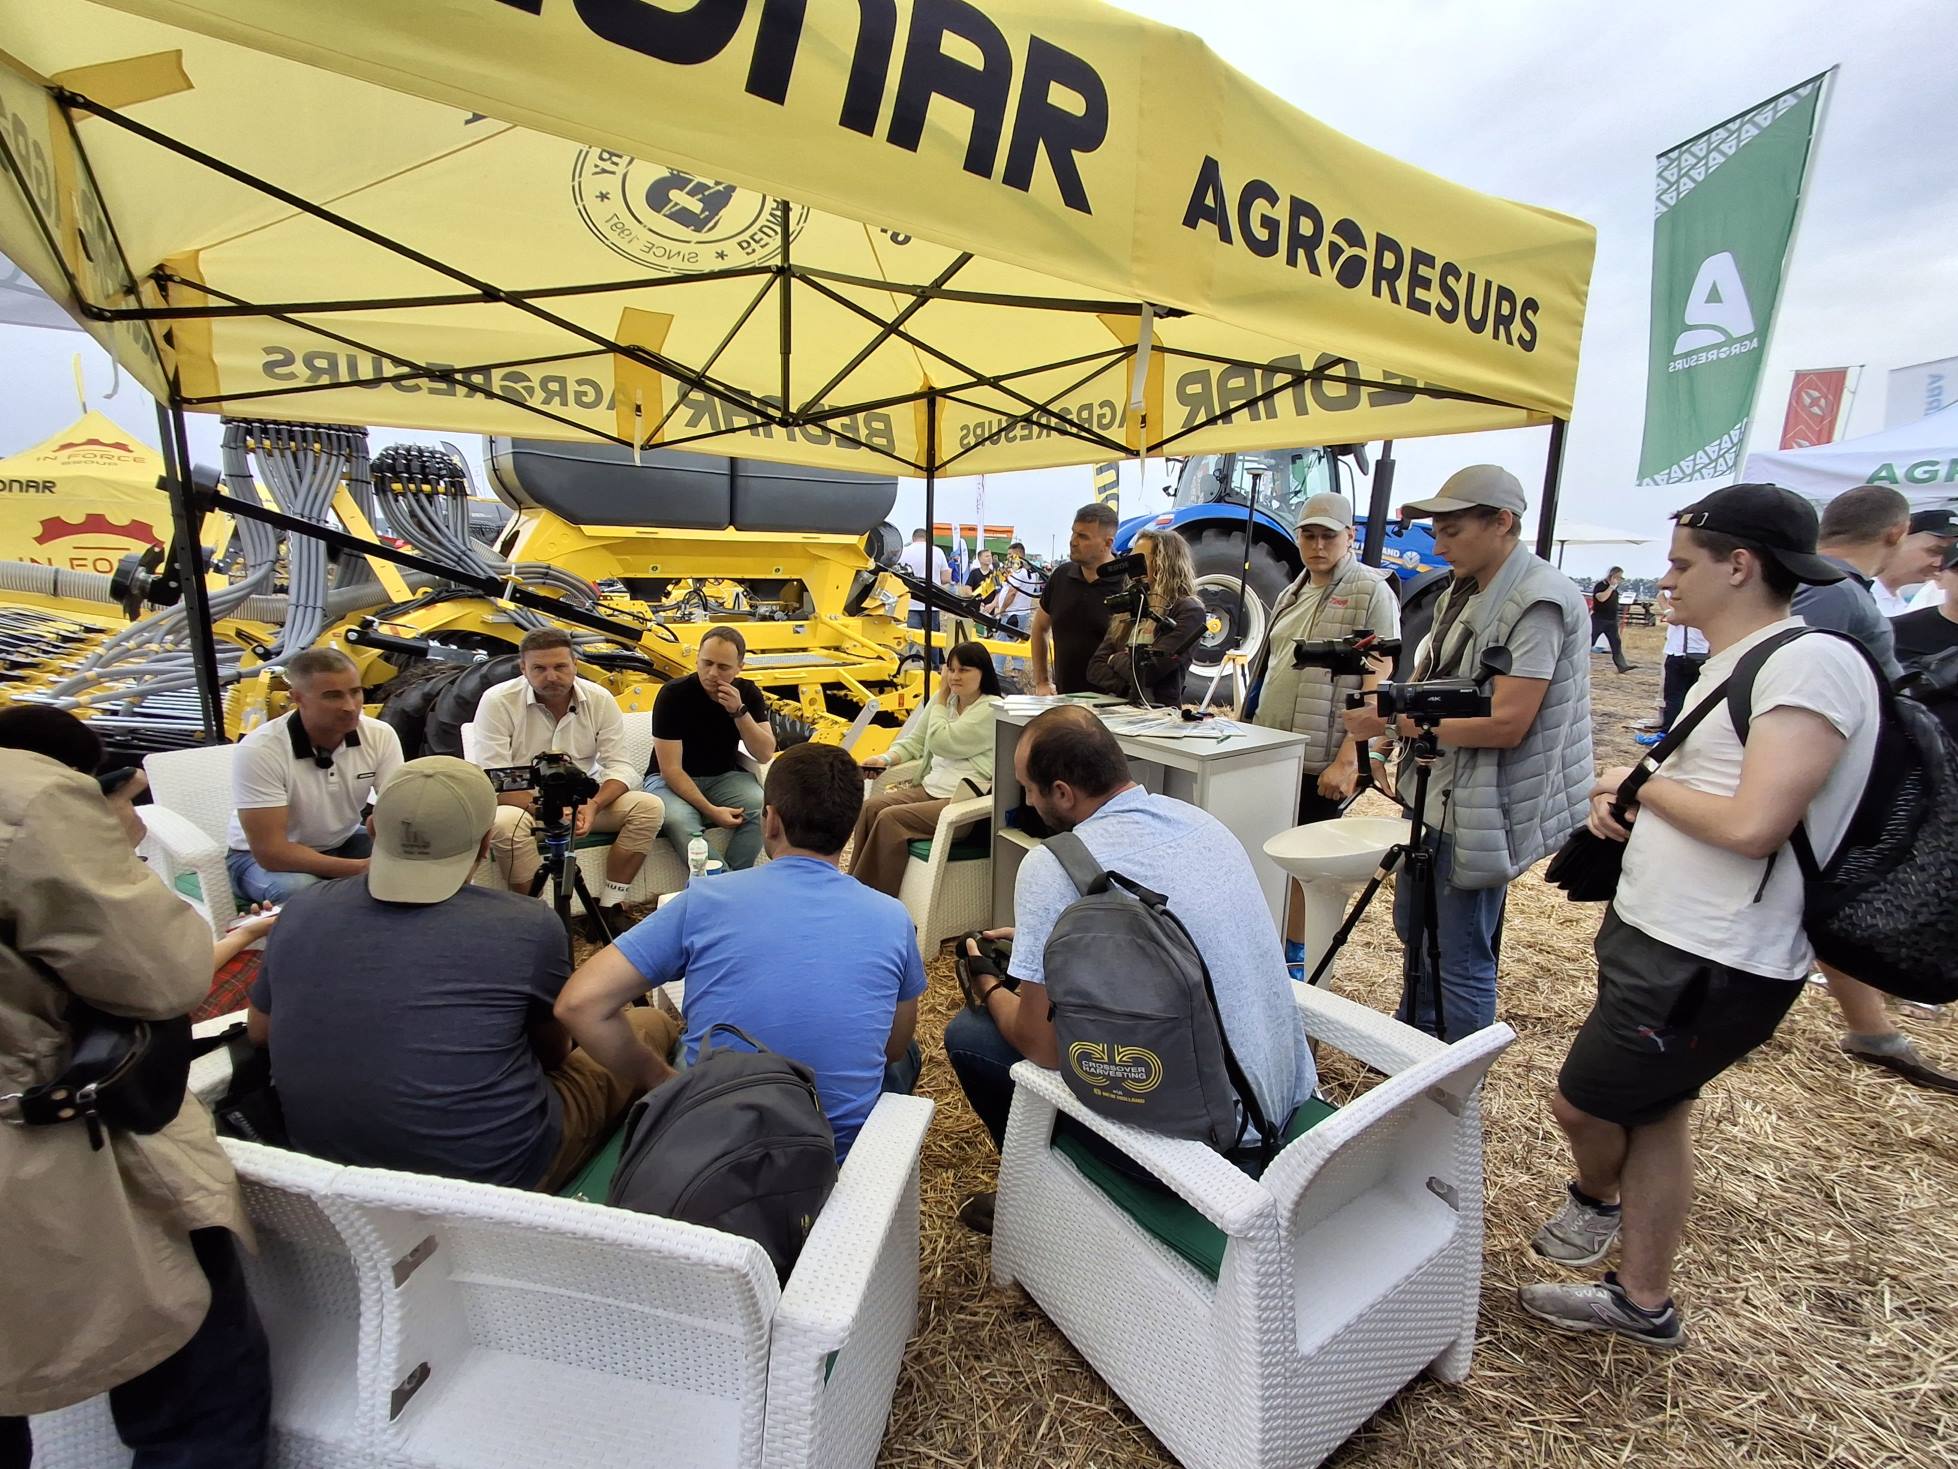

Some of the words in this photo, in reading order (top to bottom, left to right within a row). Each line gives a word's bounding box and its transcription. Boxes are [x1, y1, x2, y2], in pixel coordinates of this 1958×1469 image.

[1181, 154, 1540, 353] AGRORESURS
[67, 453, 147, 463] FORCE
[1082, 1060, 1146, 1073] CROSSOVER
[1082, 1066, 1147, 1080] HARVESTING
